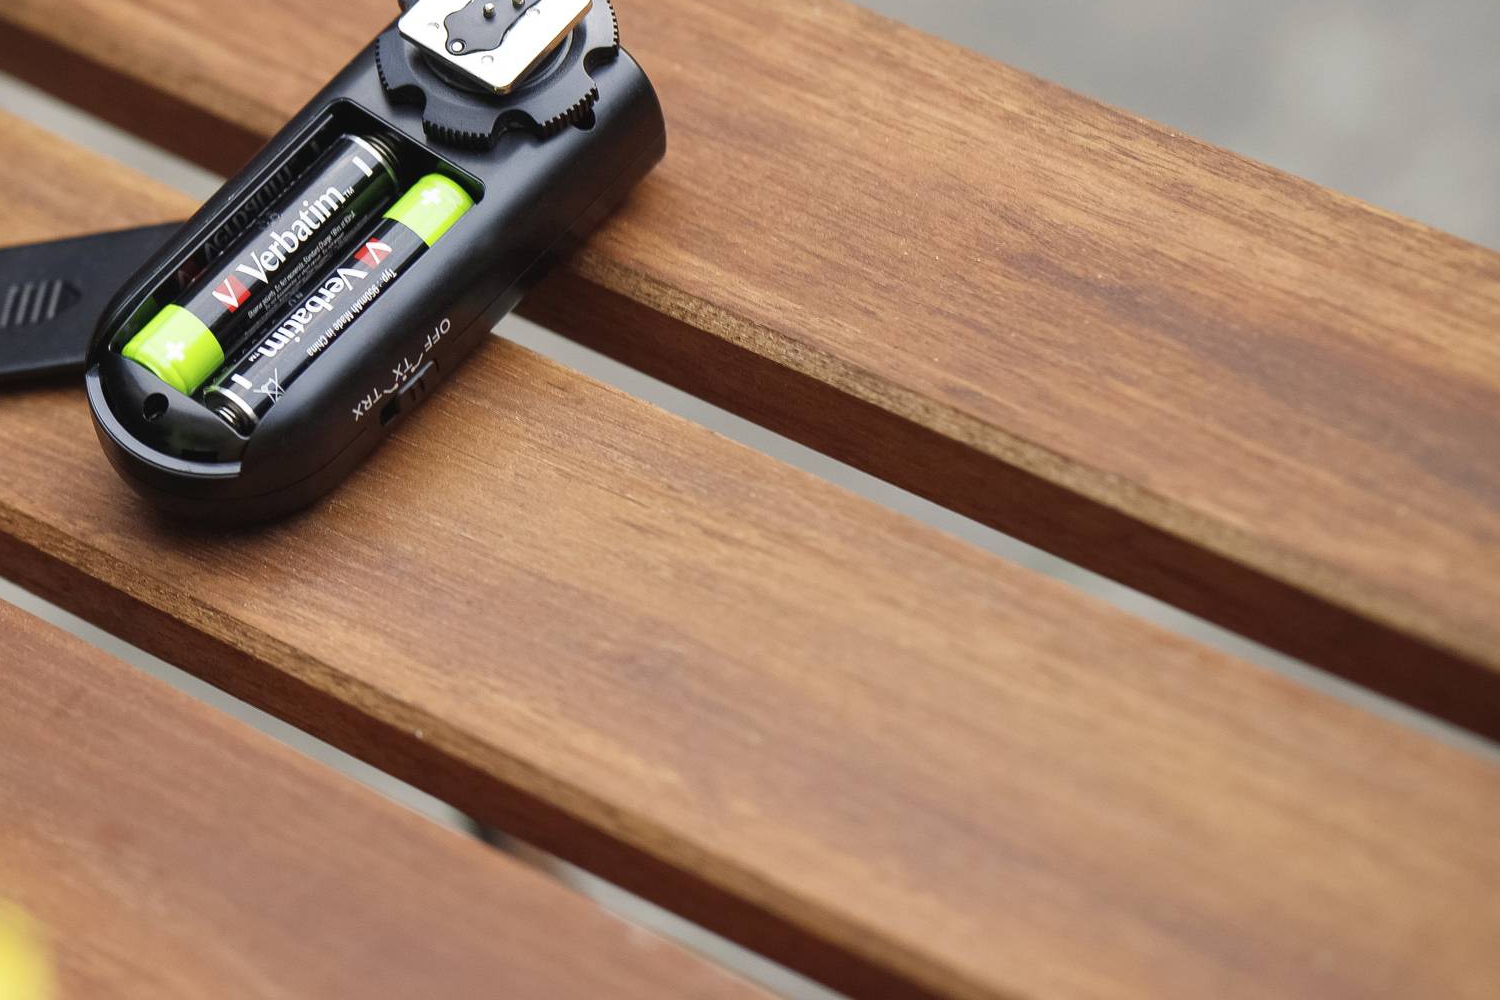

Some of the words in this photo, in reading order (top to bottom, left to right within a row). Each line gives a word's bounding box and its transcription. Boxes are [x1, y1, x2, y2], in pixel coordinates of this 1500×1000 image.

[236, 186, 347, 285] Verbatim
[257, 267, 368, 358] Verbatim
[350, 283, 381, 314] 950mAh
[325, 328, 335, 340] in
[332, 306, 354, 331] Made
[306, 336, 329, 358] China
[424, 318, 451, 353] OFF
[392, 357, 413, 381] TX
[352, 387, 382, 422] TRX
